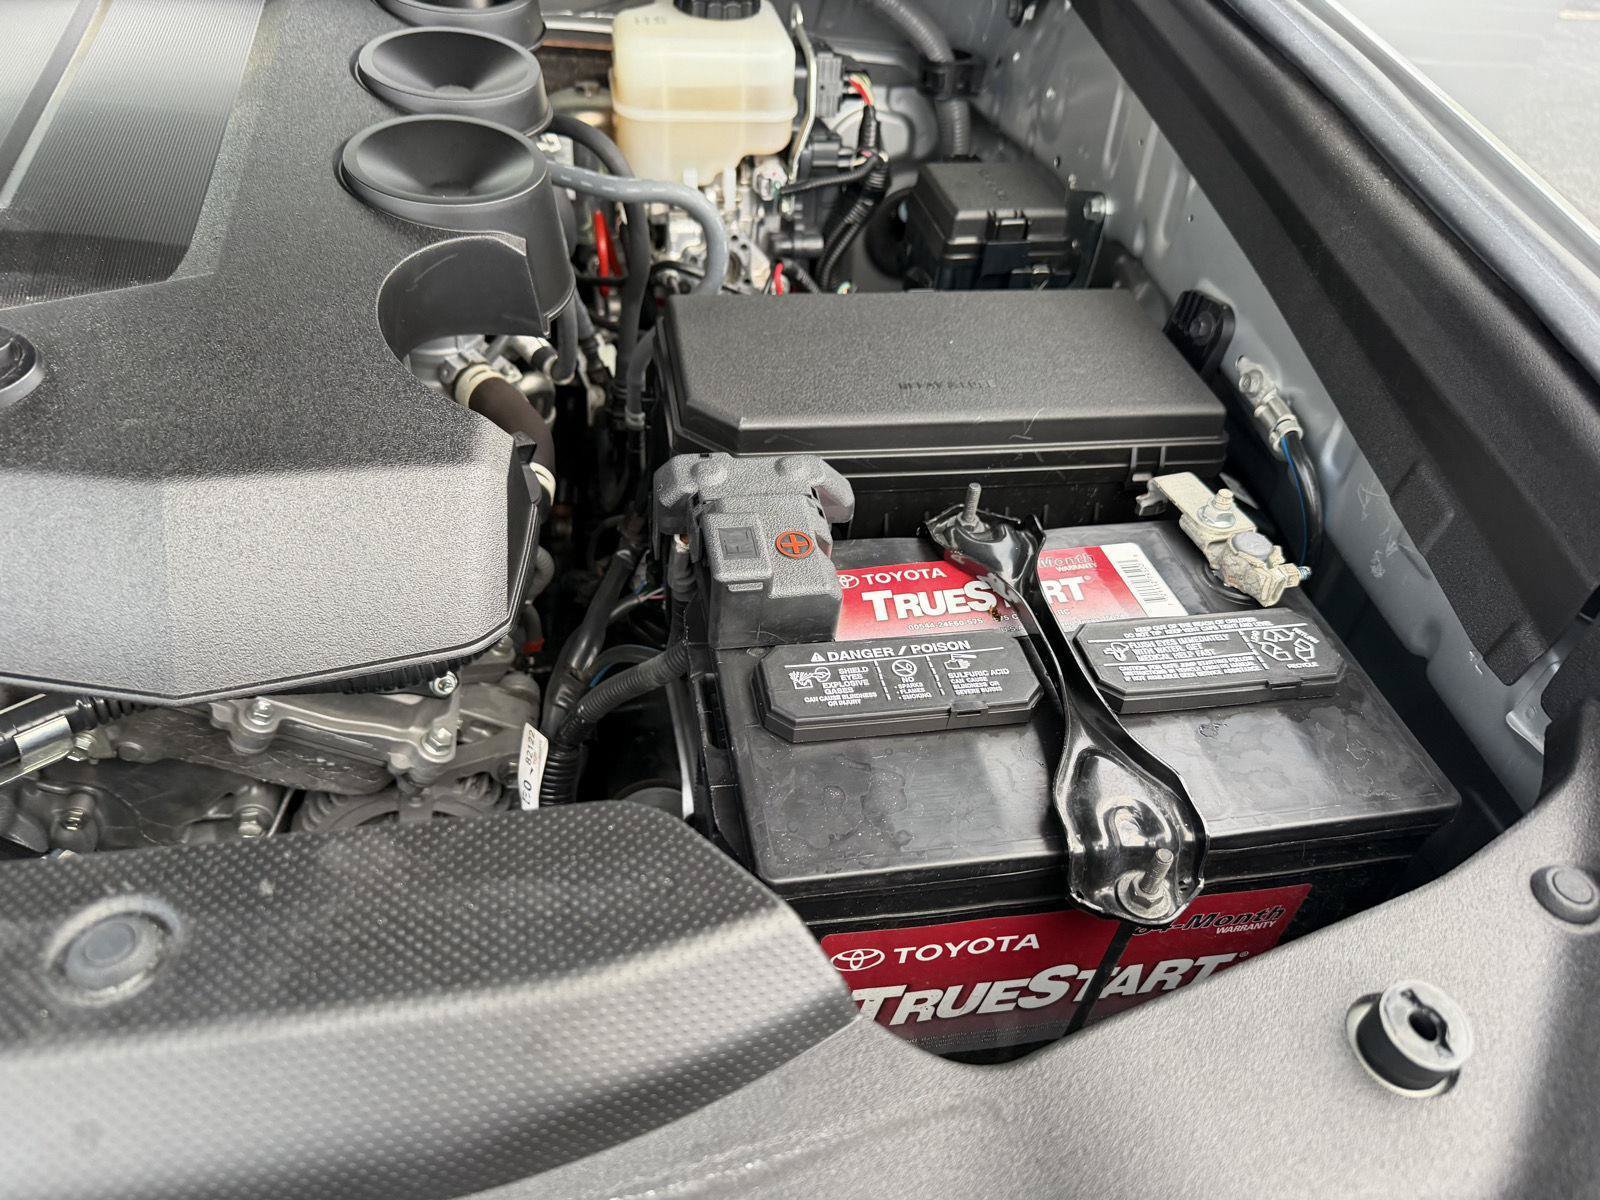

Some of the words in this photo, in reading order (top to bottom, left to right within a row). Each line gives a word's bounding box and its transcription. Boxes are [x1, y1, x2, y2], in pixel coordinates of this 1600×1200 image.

[862, 568, 948, 585] TOYOTA
[1128, 641, 1156, 650] FLUSH
[1155, 638, 1178, 647] EYES
[1178, 634, 1230, 645] IMMEDIATELY
[827, 647, 895, 661] DANGER
[910, 640, 970, 654] POISON
[1132, 648, 1154, 656] WITH
[1185, 643, 1204, 651] GET
[1136, 653, 1172, 662] MEDICAL
[838, 666, 868, 674] SHIELD
[948, 670, 989, 678] SULFURIC
[990, 668, 1010, 676] ACID
[822, 679, 870, 688] EXPLOSIVE
[953, 682, 988, 690] BLINDNESS
[902, 692, 932, 700] SMOKING
[1216, 920, 1276, 934] WARRANTY
[894, 934, 1040, 964] TOYOTA
